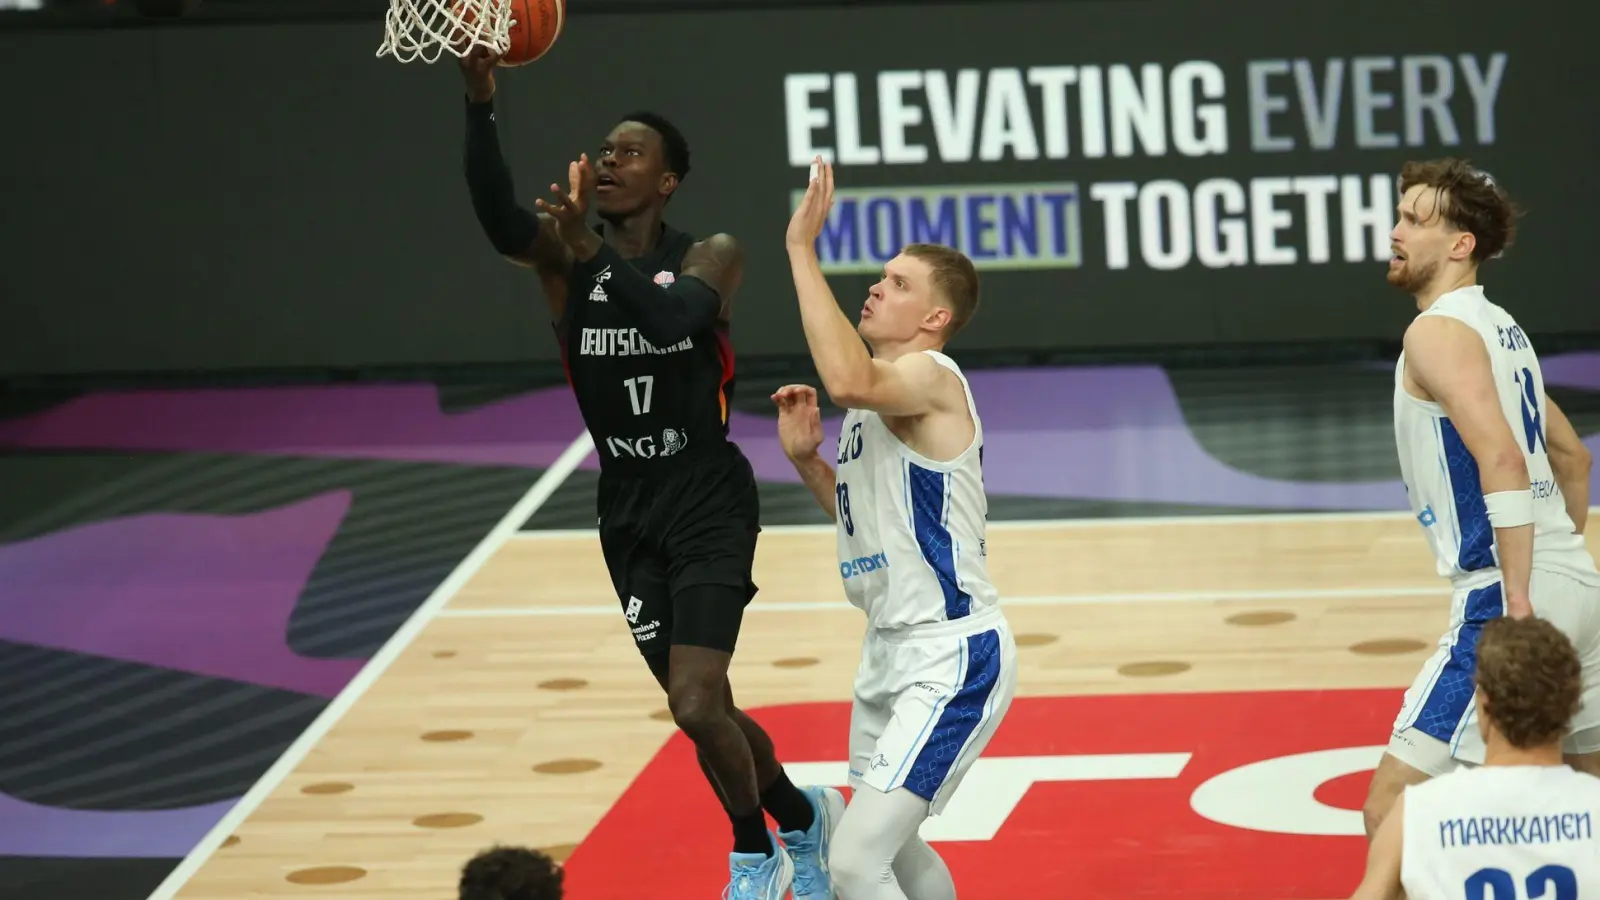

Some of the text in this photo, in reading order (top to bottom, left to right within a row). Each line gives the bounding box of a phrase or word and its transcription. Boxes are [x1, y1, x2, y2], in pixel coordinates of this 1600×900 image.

[784, 53, 1508, 167] ELEVATING EVERY
[816, 173, 1400, 270] MOMENT TOGETH
[623, 375, 654, 416] 17
[606, 434, 657, 459] ING
[1439, 812, 1592, 849] MARKKANEN
